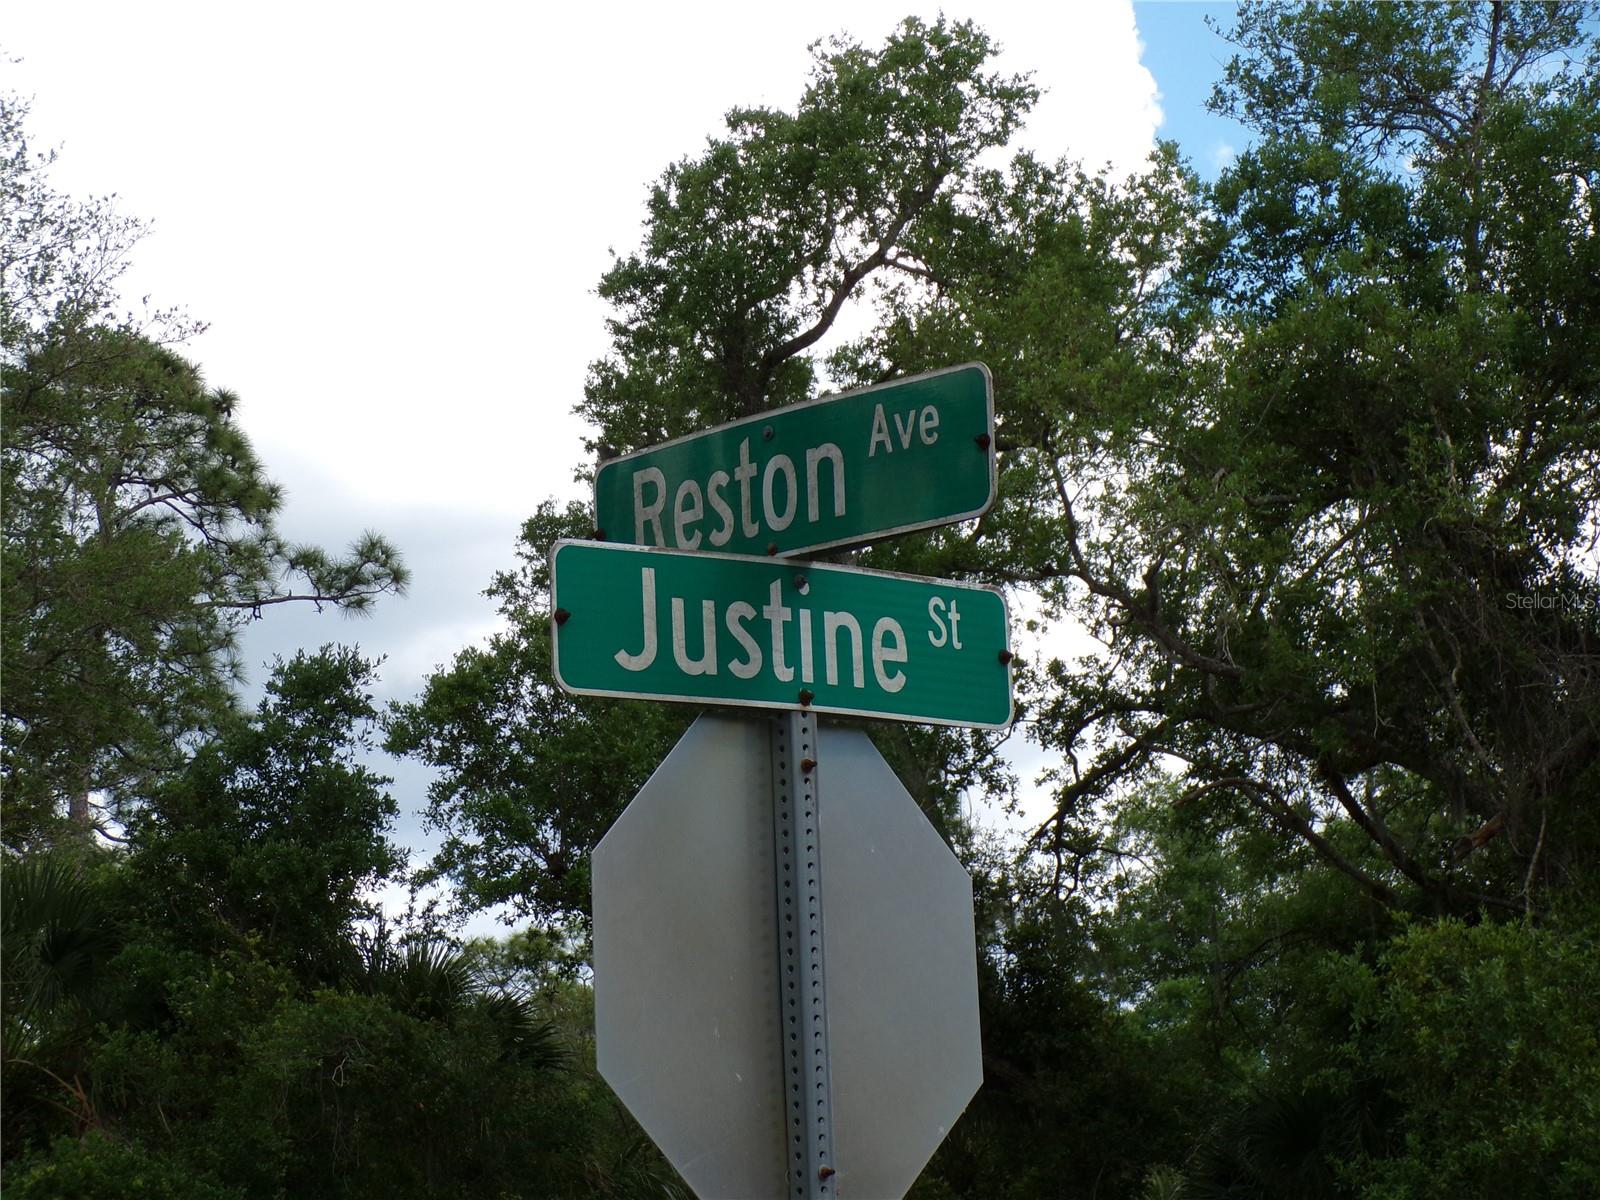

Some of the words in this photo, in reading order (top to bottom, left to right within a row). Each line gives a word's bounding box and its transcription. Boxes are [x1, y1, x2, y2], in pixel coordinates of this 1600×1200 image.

[633, 437, 845, 550] Reston
[868, 403, 940, 456] Ave
[614, 567, 908, 693] Justine
[928, 596, 962, 650] St
